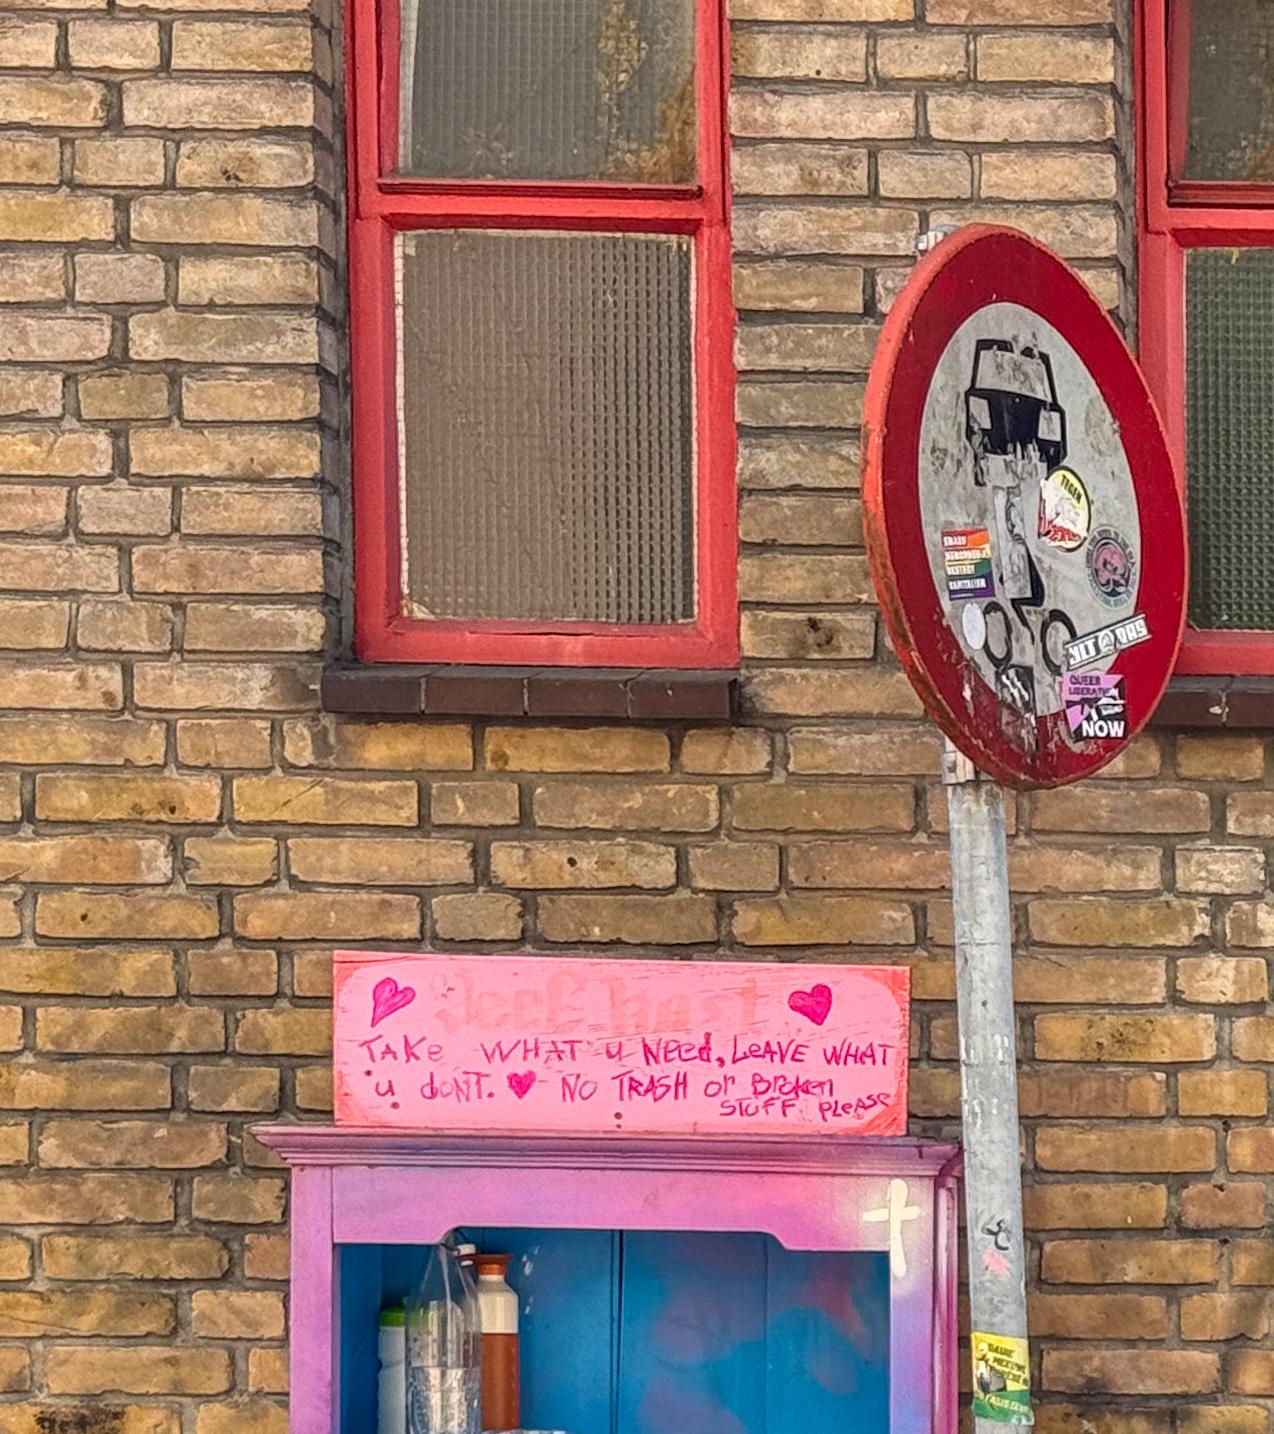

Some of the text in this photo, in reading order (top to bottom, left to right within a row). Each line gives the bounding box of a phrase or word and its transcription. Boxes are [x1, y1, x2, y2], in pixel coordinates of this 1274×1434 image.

[1060, 474, 1084, 503] TEGEN
[1069, 674, 1101, 686] QUEER
[1082, 719, 1125, 738] NOW
[480, 1037, 583, 1064] WHAT
[822, 1039, 898, 1066] WHAT
[562, 1073, 597, 1102] NO
[611, 1070, 687, 1101] TRASH
[720, 1098, 796, 1118] STUFF
